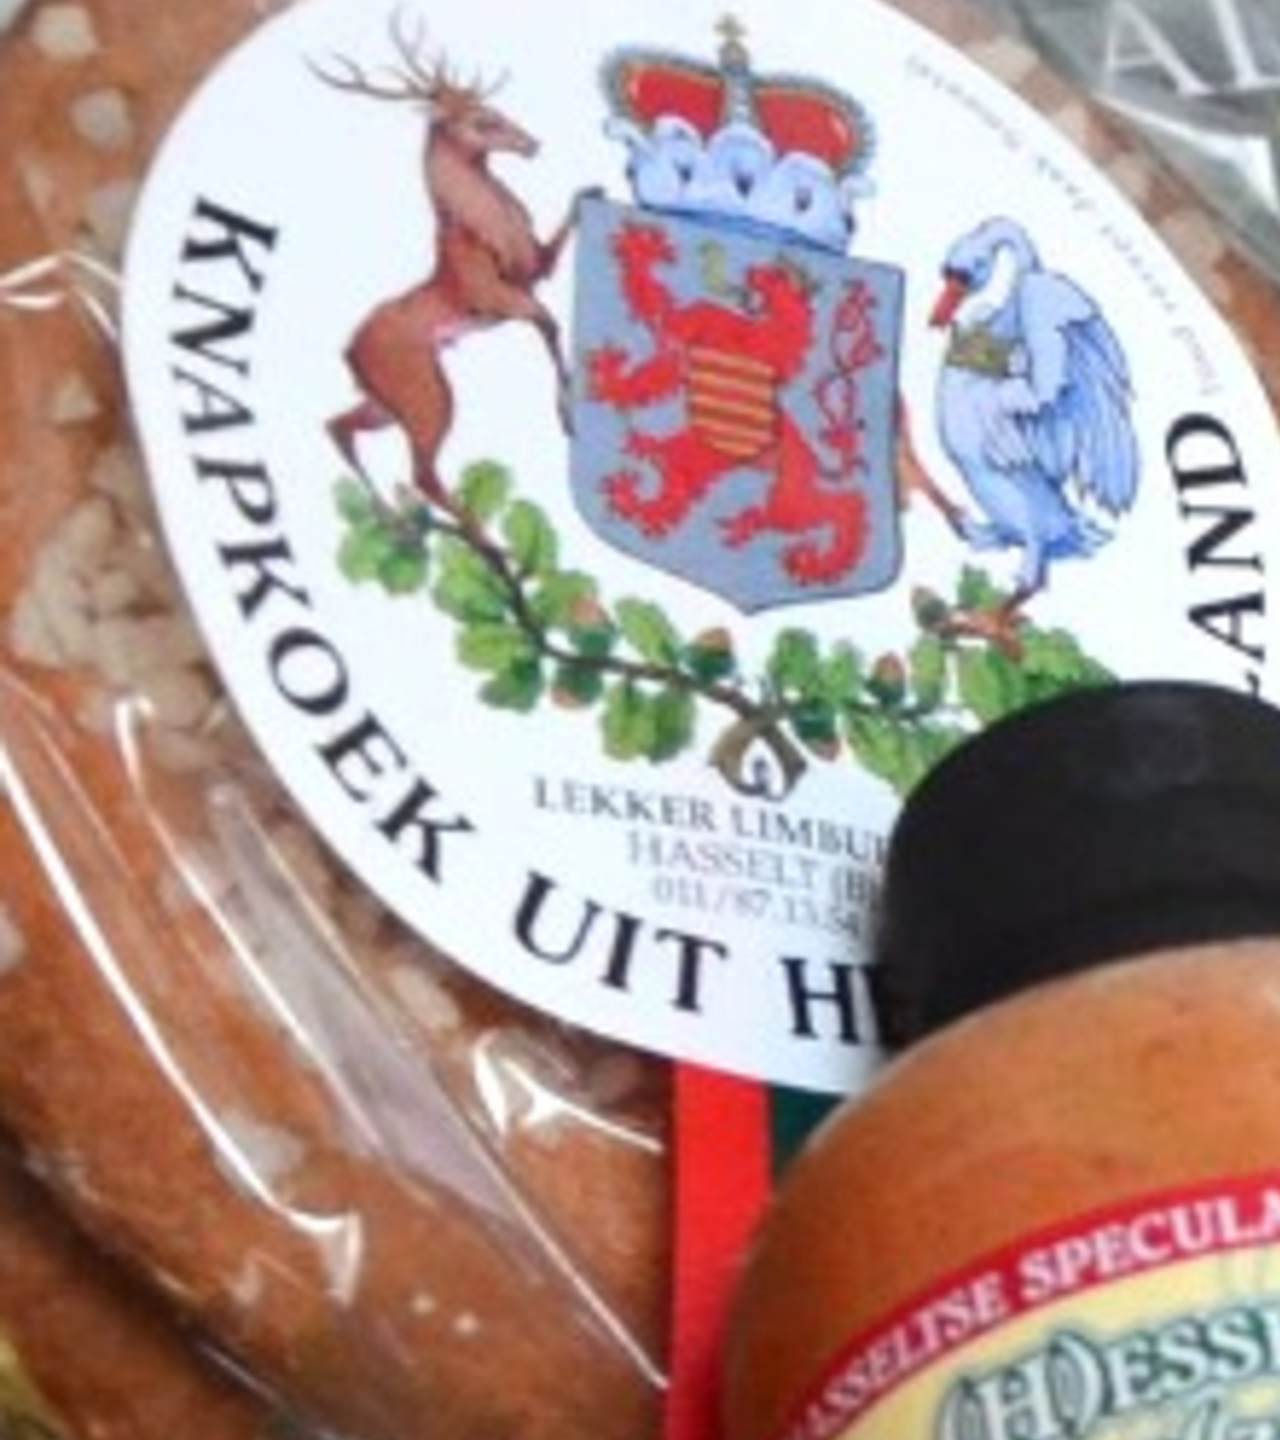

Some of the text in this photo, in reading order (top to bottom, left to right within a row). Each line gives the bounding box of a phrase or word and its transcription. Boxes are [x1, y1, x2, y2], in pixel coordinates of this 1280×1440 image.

[170, 195, 476, 884] KNAPKOEK
[513, 872, 727, 1014] UIT
[1164, 410, 1266, 702] AND
[532, 775, 716, 833] LEKKER
[627, 831, 815, 888] HASSELT
